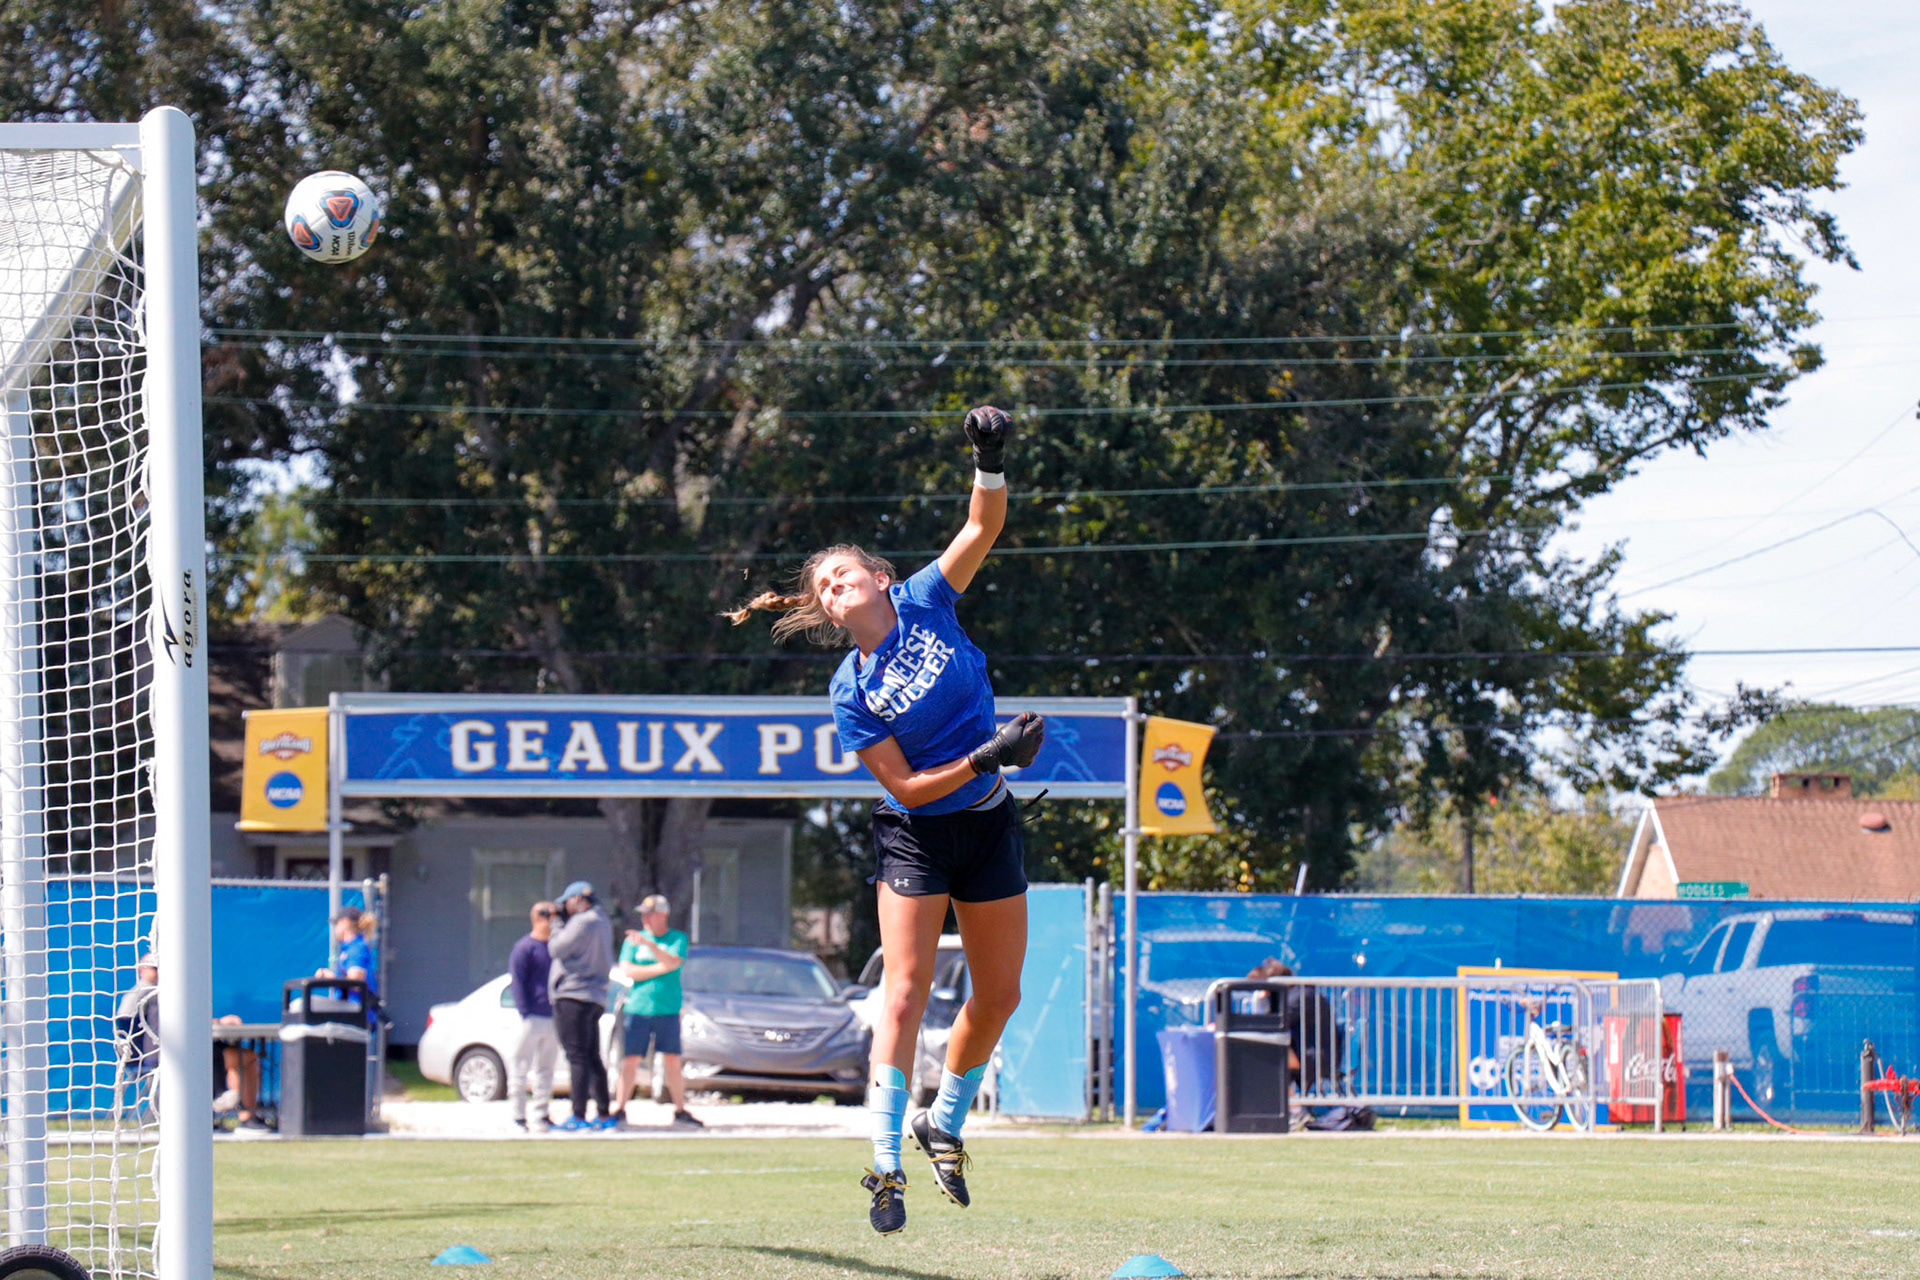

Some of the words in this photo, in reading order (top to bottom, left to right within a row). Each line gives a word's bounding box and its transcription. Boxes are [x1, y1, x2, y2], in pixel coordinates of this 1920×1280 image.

[183, 571, 194, 669] agora
[878, 638, 955, 722] SOCCER
[450, 719, 724, 773] GEAUX
